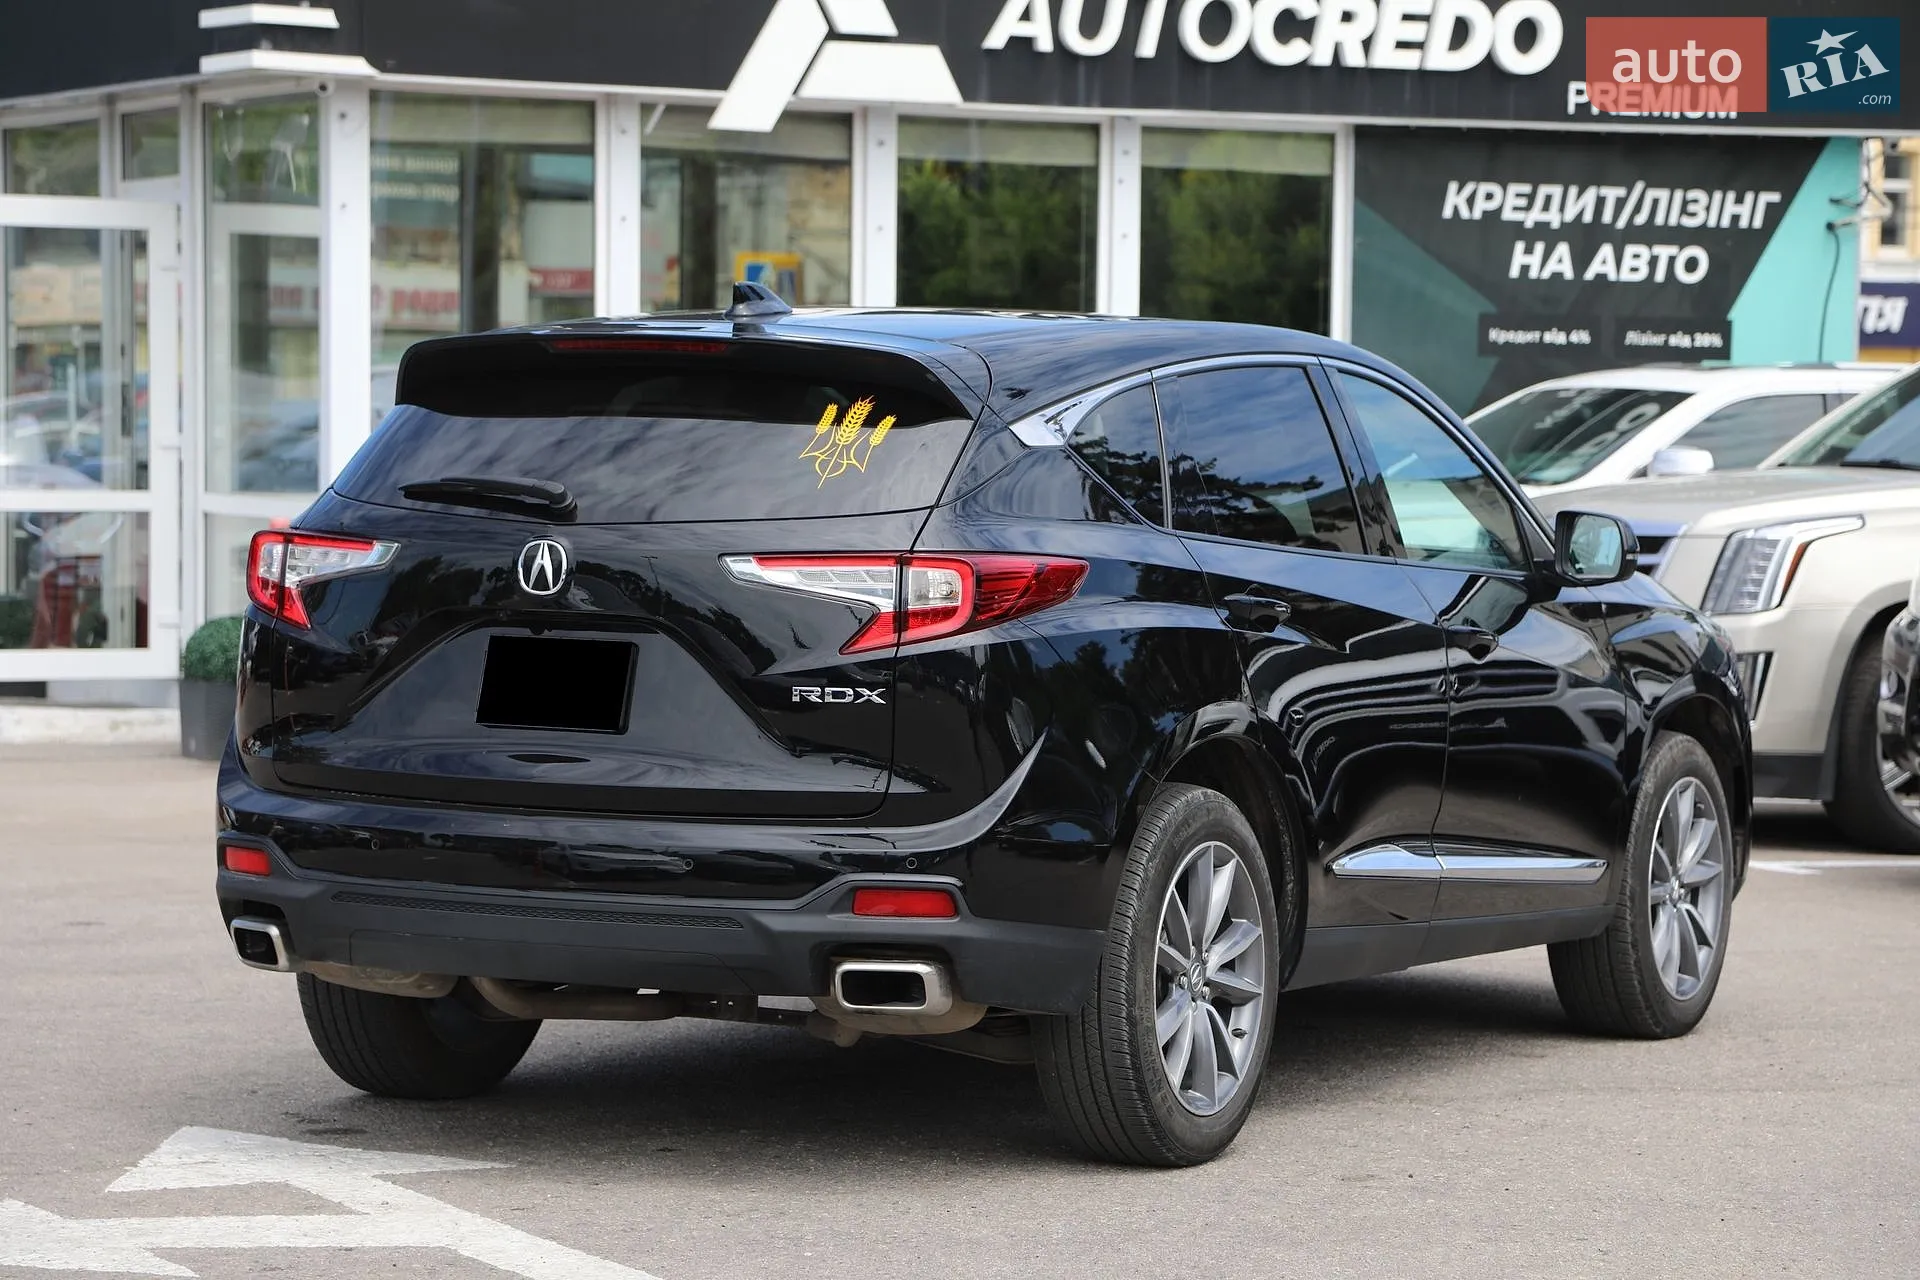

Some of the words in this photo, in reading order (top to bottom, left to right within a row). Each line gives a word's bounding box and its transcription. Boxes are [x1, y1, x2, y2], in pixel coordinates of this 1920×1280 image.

[980, 0, 1564, 76] AUTOCREDO
[1567, 80, 1738, 119] PREMIUM
[1442, 180, 1782, 230] КРЕДИТ/ЛІЗІНГ
[1508, 239, 1575, 280] НА
[1583, 243, 1710, 285] АВТО
[792, 686, 887, 704] RDX
